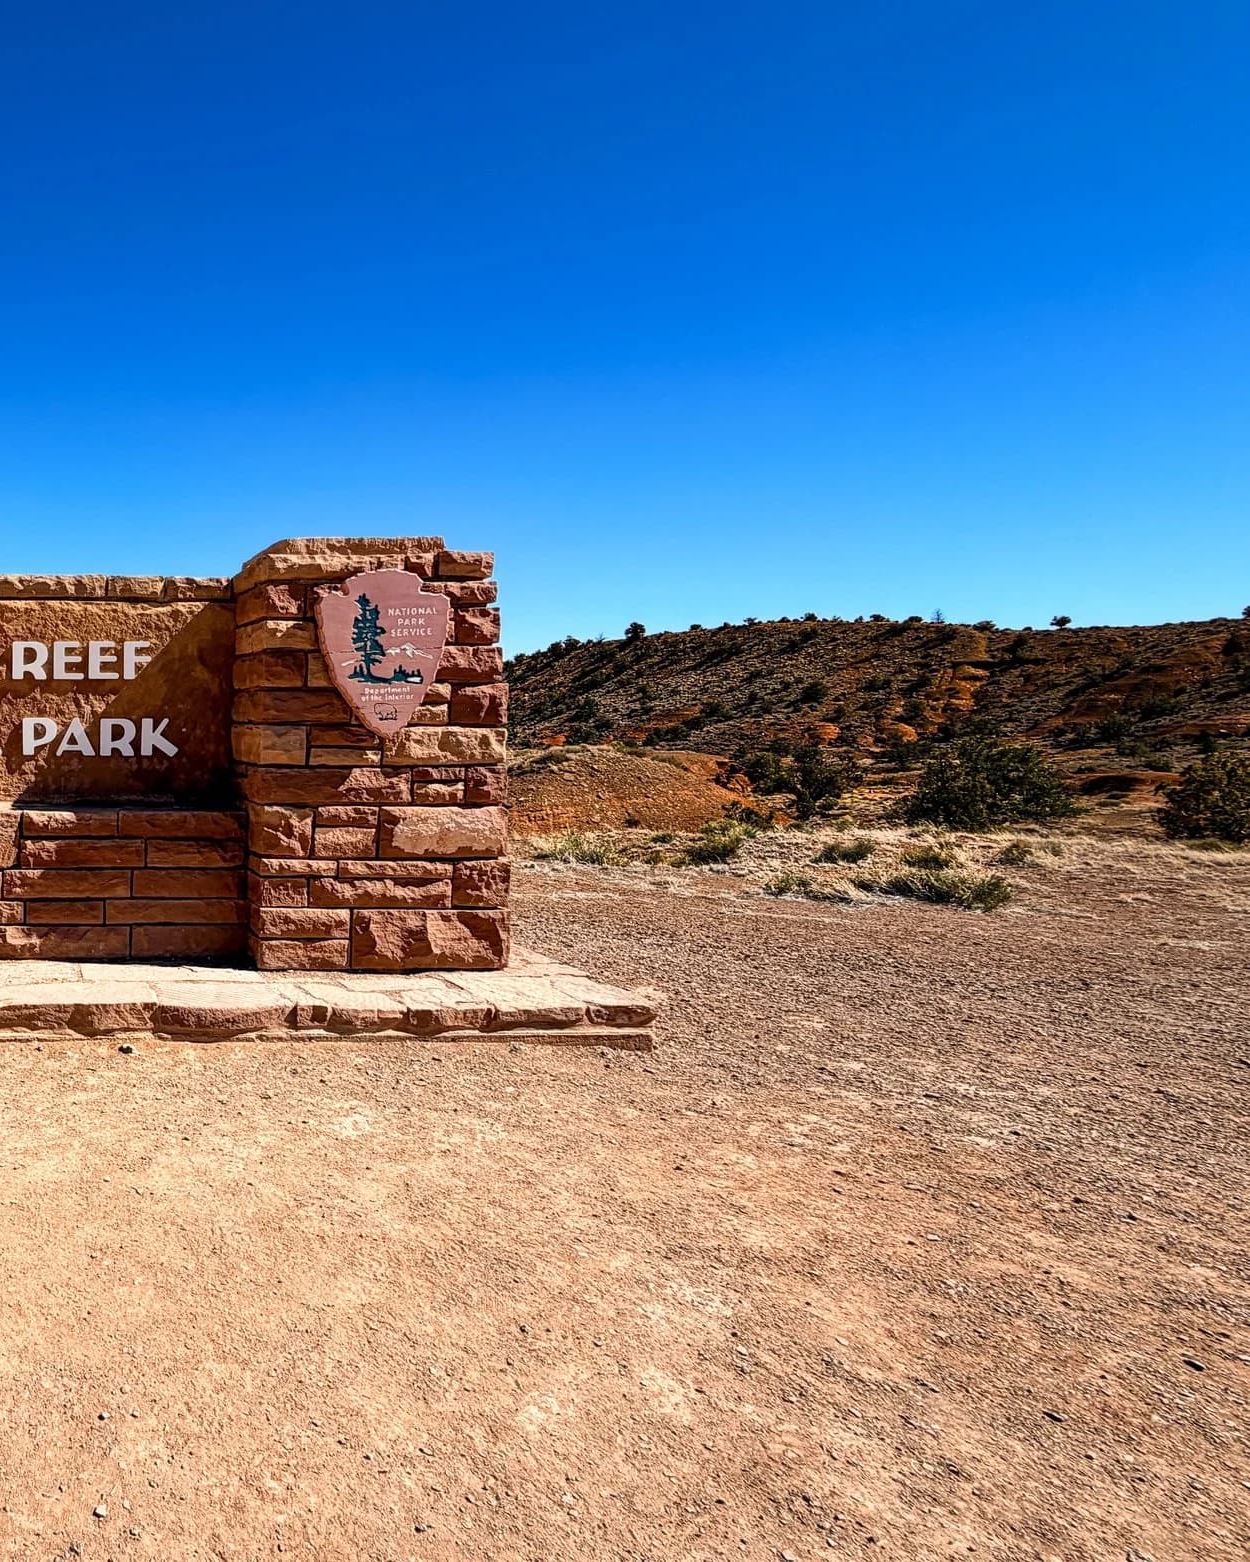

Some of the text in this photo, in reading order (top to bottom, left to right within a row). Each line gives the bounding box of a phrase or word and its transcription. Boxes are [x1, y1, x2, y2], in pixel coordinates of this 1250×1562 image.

[388, 607, 438, 616] NATIONAL
[397, 617, 426, 626] PARK
[390, 627, 433, 637] SERVICE
[12, 640, 152, 680] REEF
[364, 685, 410, 694] Department
[22, 717, 179, 757] PARK
